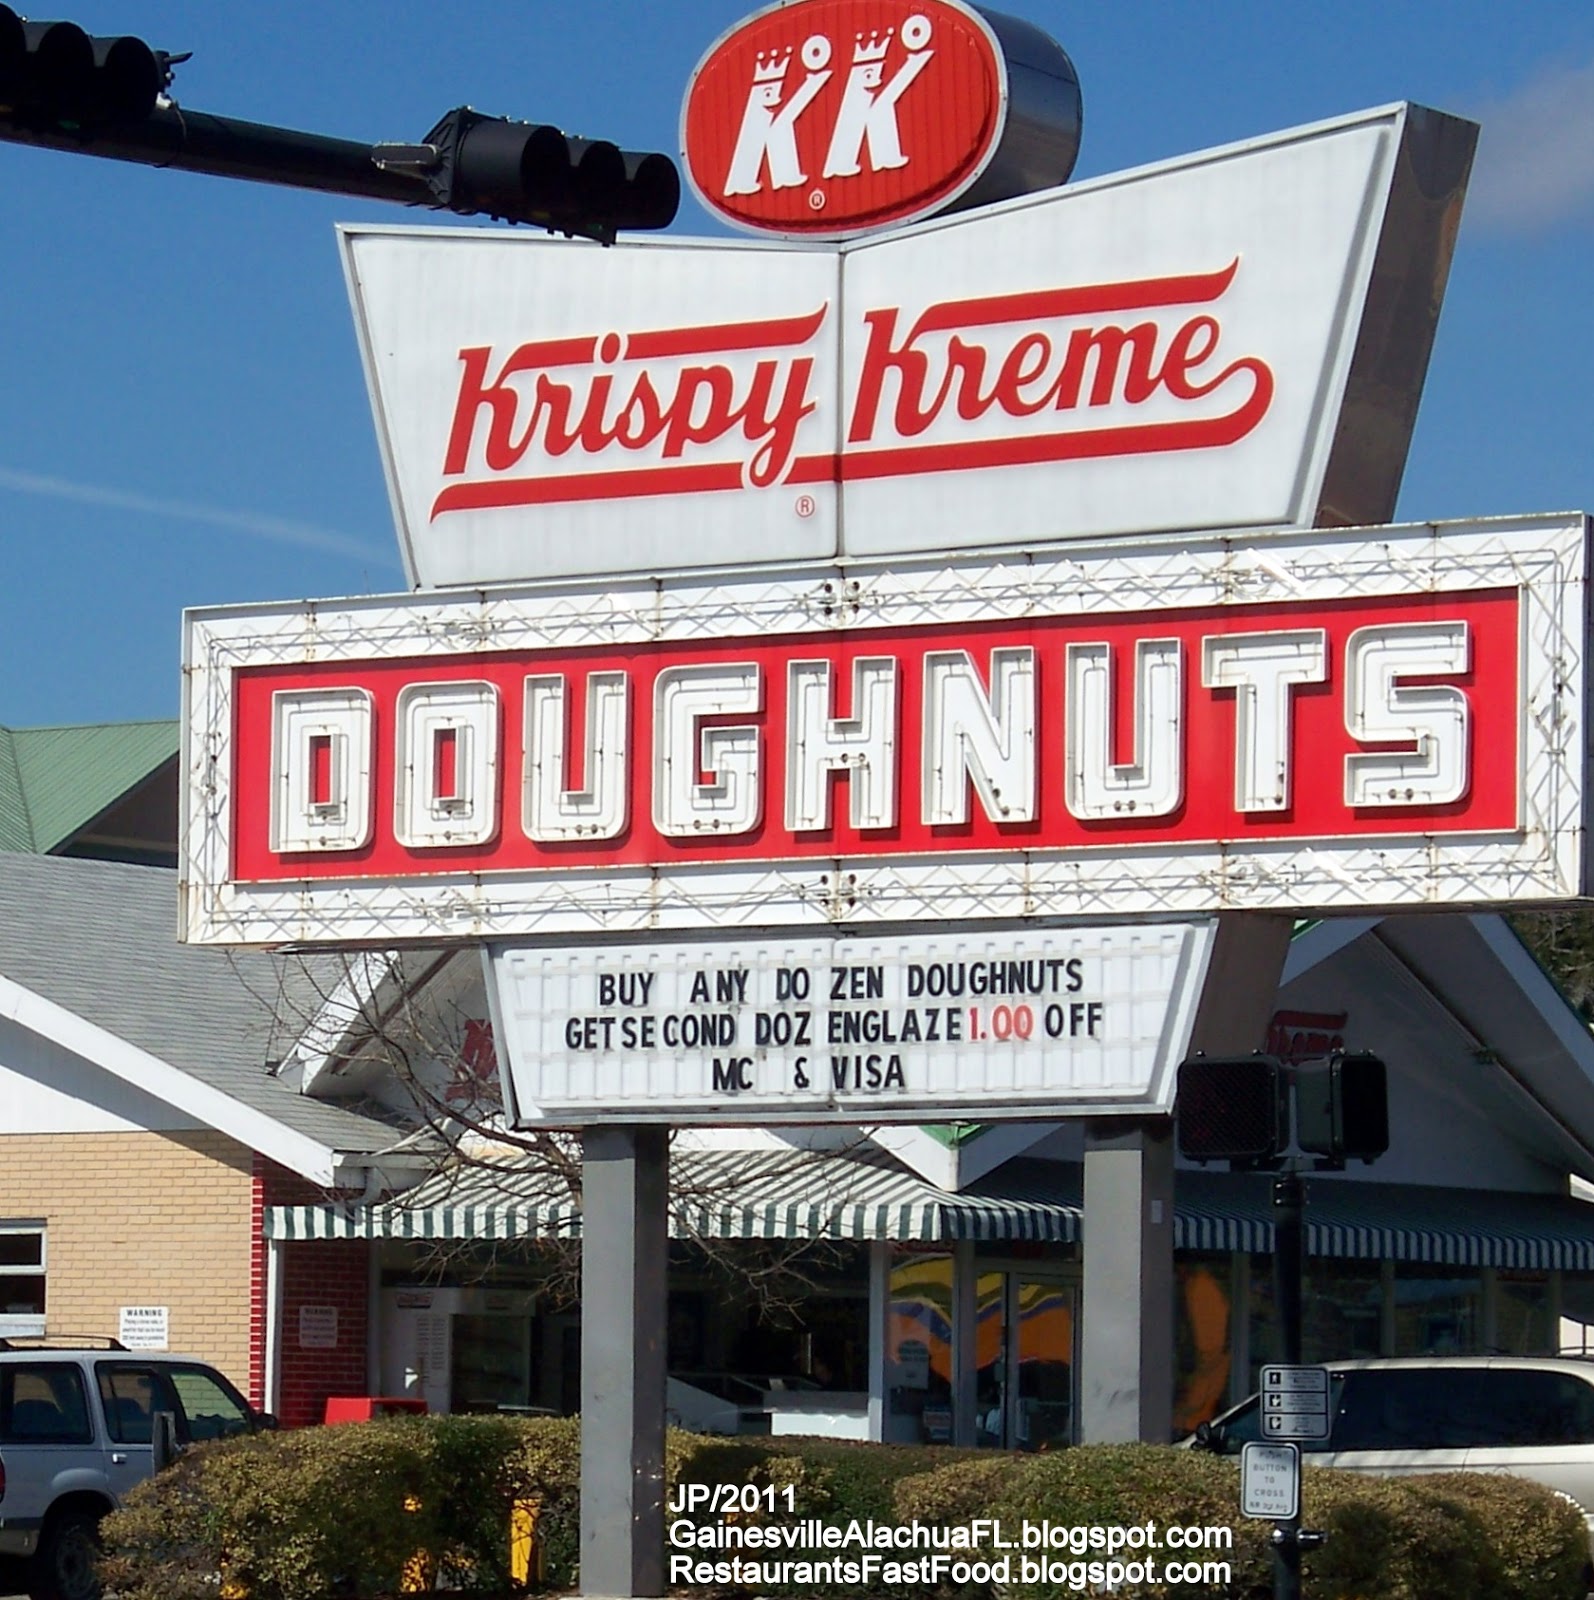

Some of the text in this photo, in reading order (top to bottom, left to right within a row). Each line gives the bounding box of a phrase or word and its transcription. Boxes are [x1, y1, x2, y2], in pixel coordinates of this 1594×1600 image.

[440, 300, 1275, 490] Krispy Kreme
[267, 619, 1471, 855] DOUGHNUTS
[599, 972, 654, 1006] BUY
[689, 969, 749, 1003] ANY
[908, 958, 1083, 997] DOUGHNUTS
[1044, 1002, 1103, 1038] OFF
[712, 1054, 906, 1091] MC & VISA
[126, 1308, 163, 1317] WARNING
[1253, 1463, 1288, 1473] BUTTON
[1264, 1475, 1275, 1484] TO
[1254, 1488, 1285, 1498] CROSS
